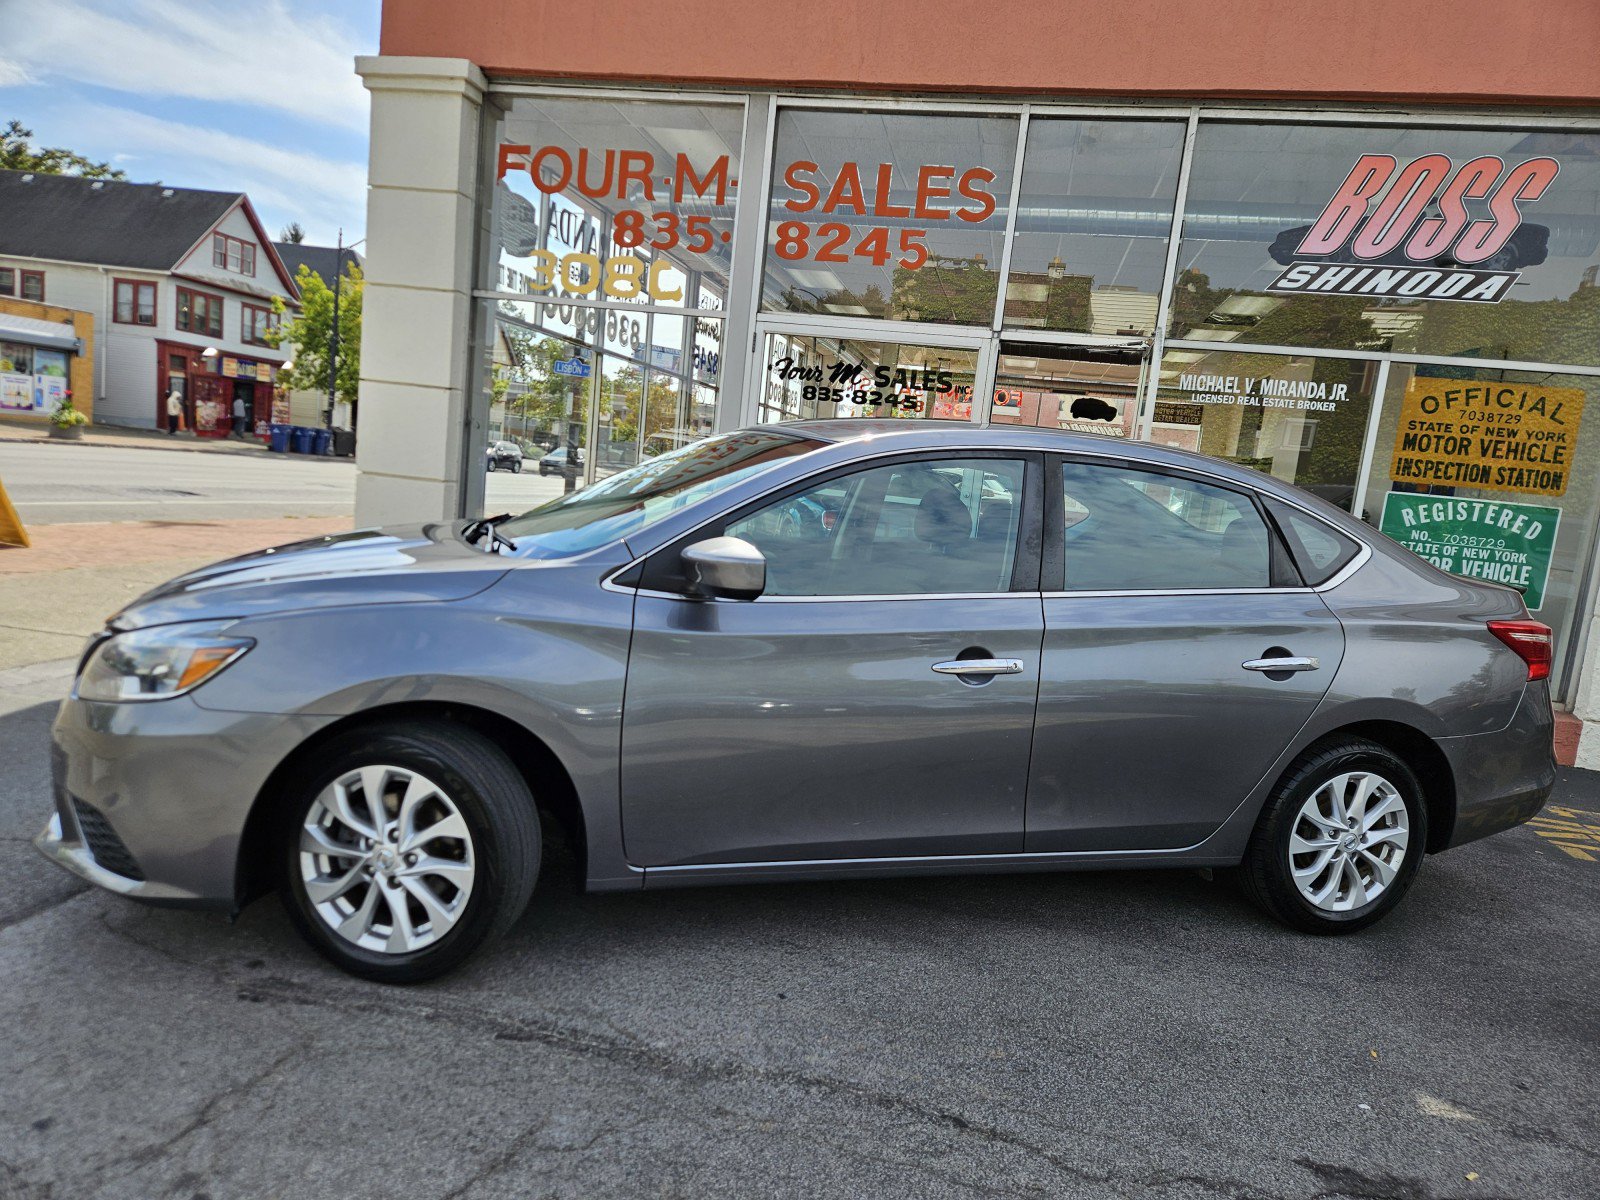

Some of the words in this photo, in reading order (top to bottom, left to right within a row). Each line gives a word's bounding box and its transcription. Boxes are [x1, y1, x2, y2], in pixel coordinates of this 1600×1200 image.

[784, 160, 996, 223] SALES
[1293, 153, 1560, 264] BOSS
[774, 220, 929, 271] 8245
[1277, 265, 1509, 300] SHINODA
[556, 362, 583, 375] LISBON
[874, 365, 954, 394] SALES
[1179, 374, 1241, 394] MICHAEL
[1245, 377, 1256, 395] V.
[1260, 379, 1327, 400] MIRANDA
[1329, 383, 1350, 402] JR.
[1191, 393, 1235, 404] LICENSED
[1237, 396, 1261, 407] REAL
[1262, 398, 1295, 409] ESTATE
[1297, 401, 1336, 412] BROKER
[1420, 387, 1566, 426] OFFICIAL
[1459, 409, 1522, 425] 7038729
[1408, 420, 1453, 433] STATE
[1459, 424, 1480, 435] OF
[1485, 426, 1519, 439] NEW
[1525, 429, 1567, 443] YORK
[1402, 432, 1472, 456] MOTOR
[1480, 438, 1567, 465] VEHICLE
[1395, 457, 1492, 484] INSPECTION
[1495, 466, 1564, 491] STATION
[1401, 501, 1543, 540] REGISTERED
[1400, 541, 1439, 554] STATE
[1443, 545, 1459, 556] OF
[1462, 548, 1491, 560] NEW
[1495, 550, 1528, 564] YORK
[1442, 533, 1506, 549] 7038729
